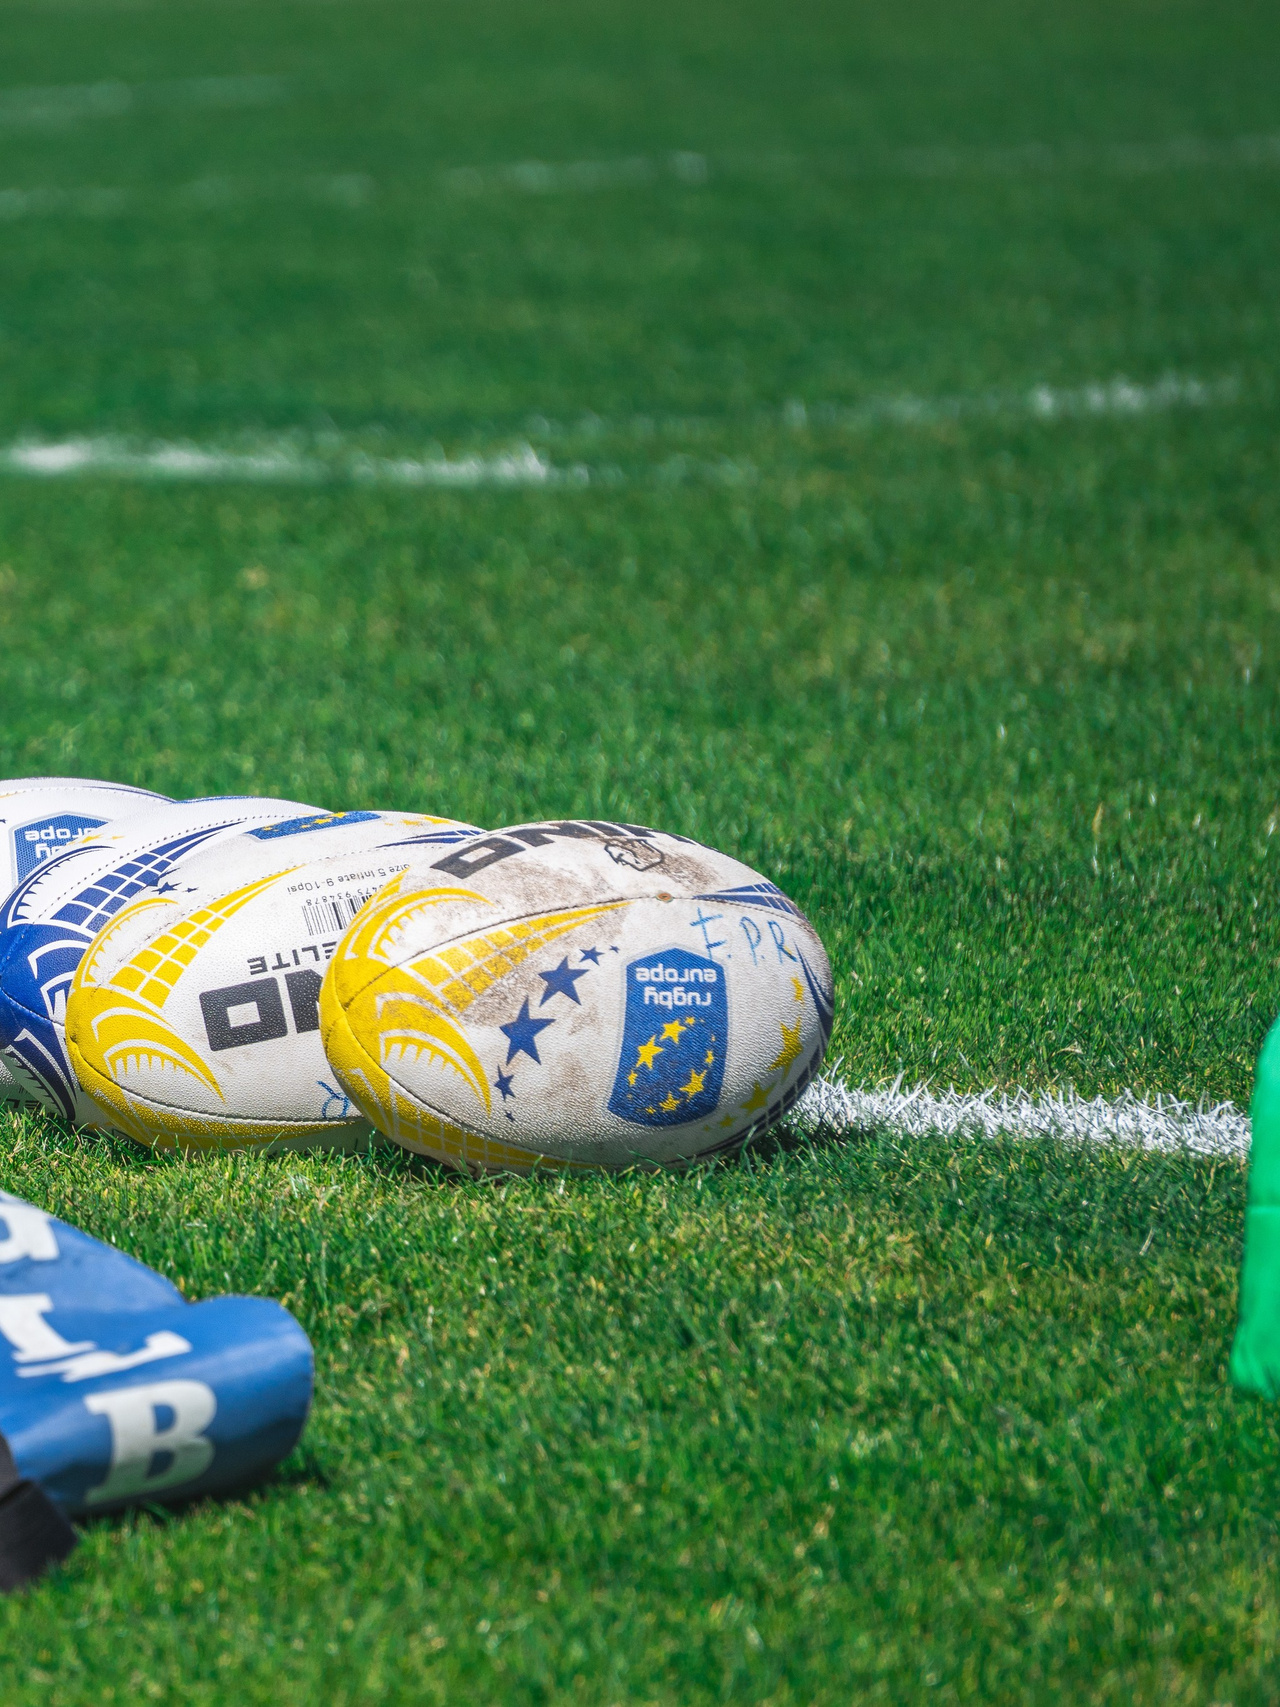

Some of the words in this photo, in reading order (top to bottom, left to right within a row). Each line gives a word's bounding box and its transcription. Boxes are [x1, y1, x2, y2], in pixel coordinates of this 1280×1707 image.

[24, 826, 96, 842] rope
[338, 870, 375, 884] Inflate
[377, 868, 386, 877] 5
[286, 877, 334, 895] 9-10psi
[305, 891, 352, 907] 934878
[247, 942, 338, 975] ELITE
[635, 962, 718, 983] europe
[643, 986, 713, 1010] rugby
